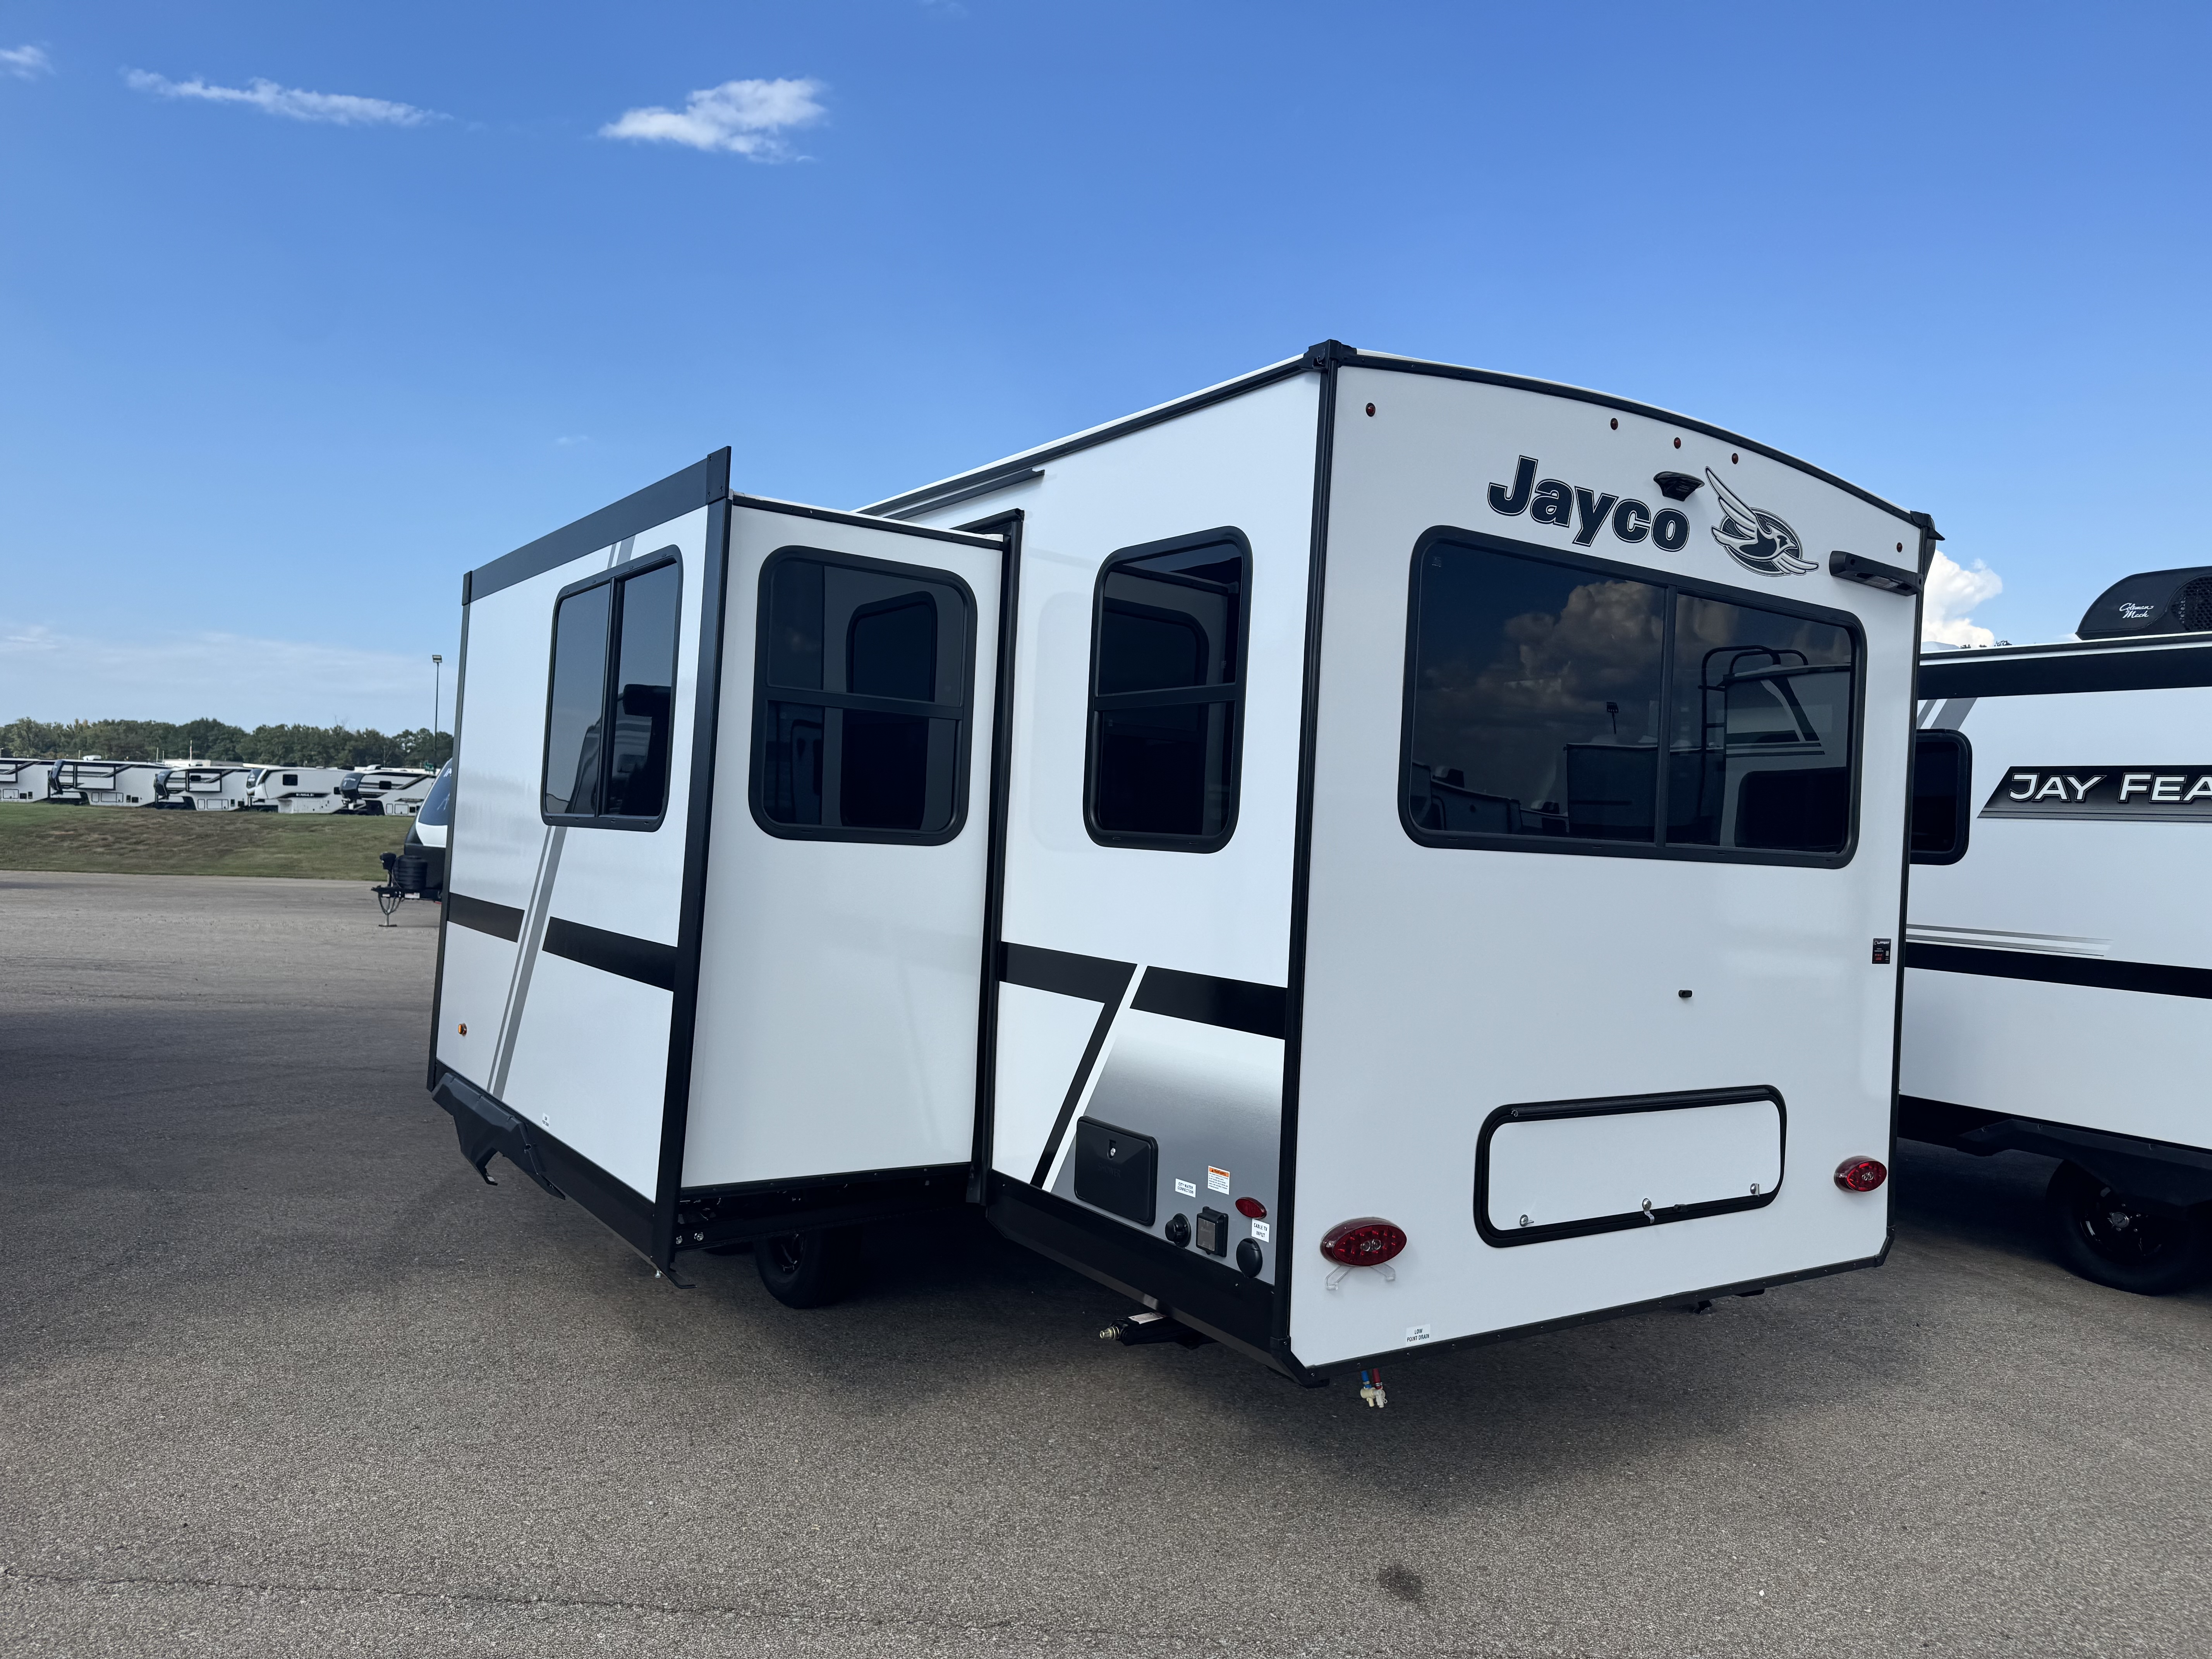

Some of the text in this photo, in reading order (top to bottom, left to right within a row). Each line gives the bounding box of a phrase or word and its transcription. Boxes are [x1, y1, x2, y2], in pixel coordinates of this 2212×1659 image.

[1487, 455, 1690, 552] Jayco
[2008, 773, 2212, 802] JAY FEA
[1097, 1162, 1121, 1178] SHOWER
